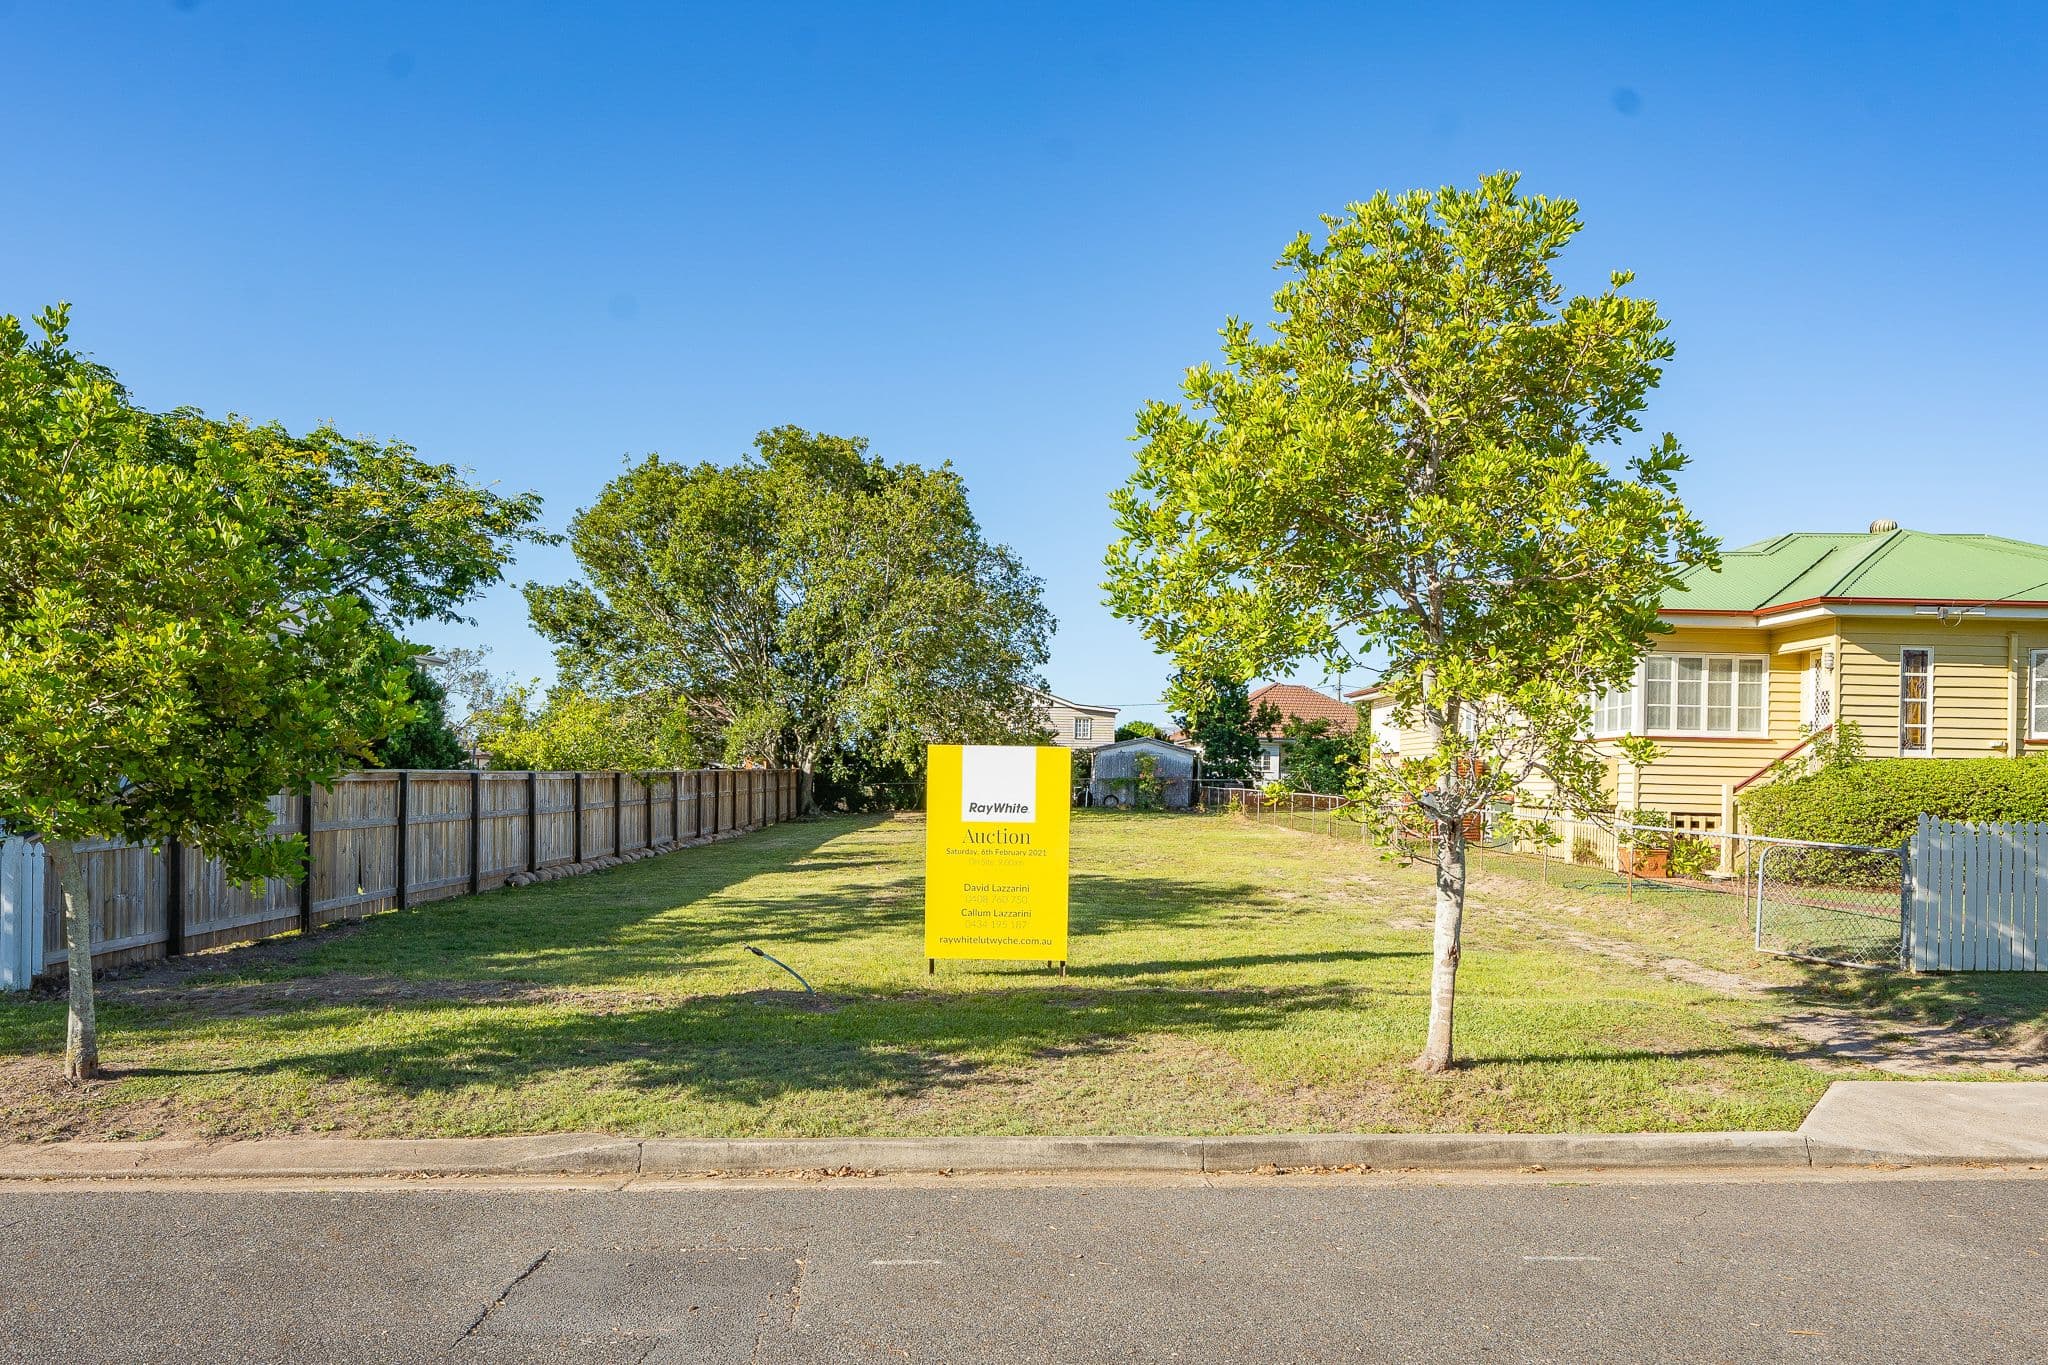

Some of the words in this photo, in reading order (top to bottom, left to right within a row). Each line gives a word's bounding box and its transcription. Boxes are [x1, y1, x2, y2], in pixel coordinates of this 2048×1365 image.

[963, 828, 1030, 844] Auction
[995, 848, 1027, 857] February
[1028, 849, 1047, 857] 2021
[963, 883, 989, 892] David
[992, 884, 1030, 893] Lazzarini
[961, 908, 991, 917] Callum
[993, 909, 1032, 918] Lazzarini
[939, 935, 1052, 946] raywhitelutwyche.com.au
